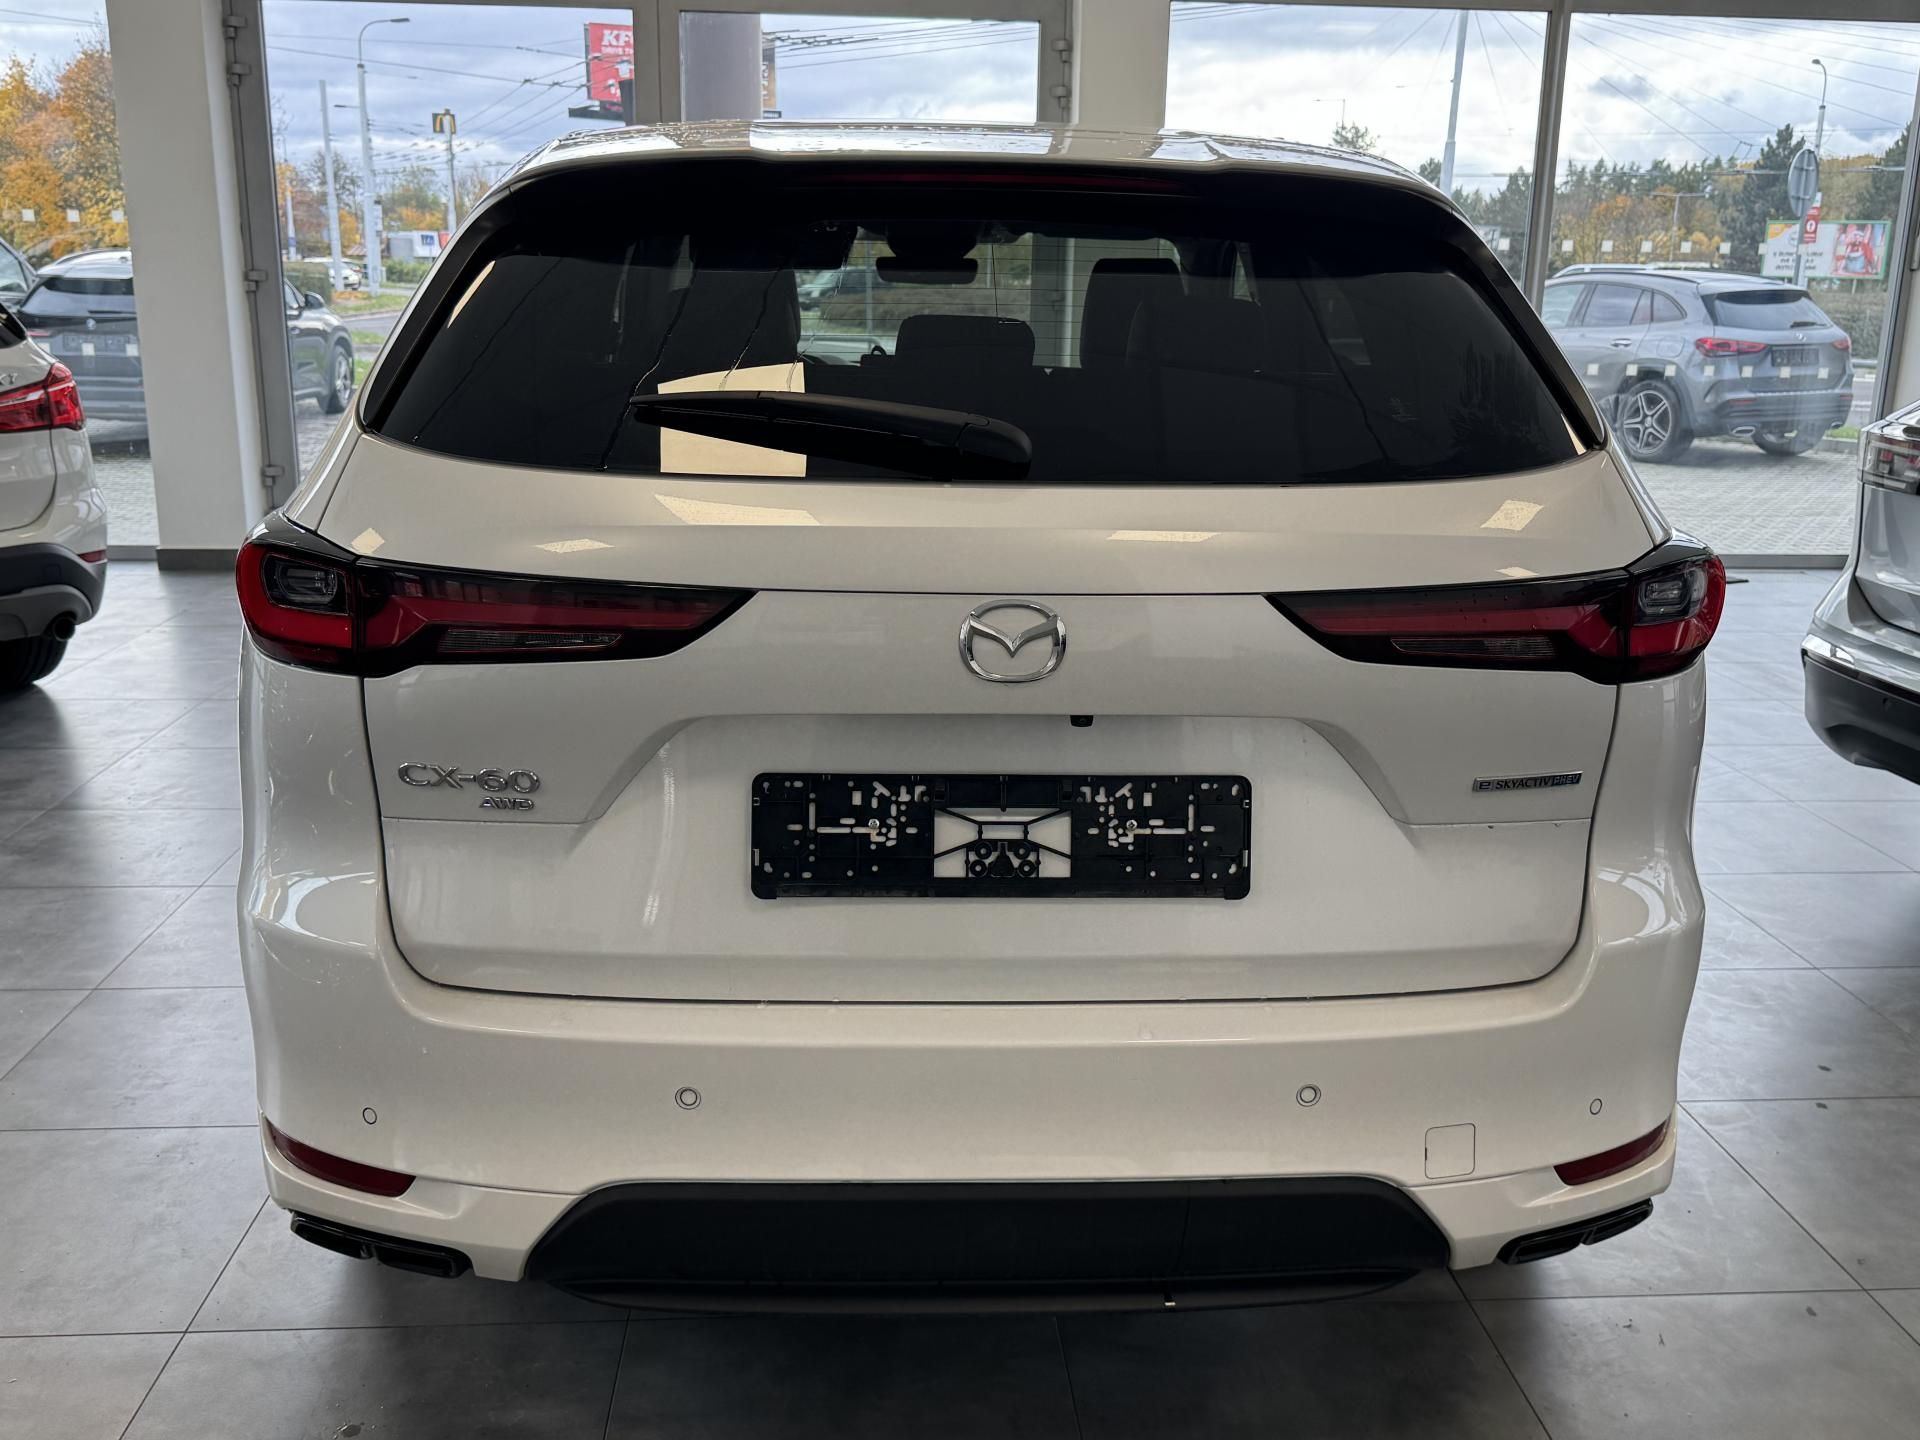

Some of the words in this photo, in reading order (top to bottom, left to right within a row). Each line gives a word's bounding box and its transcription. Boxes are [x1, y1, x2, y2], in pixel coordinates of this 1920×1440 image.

[601, 29, 633, 46] KF
[398, 762, 540, 793] CX-60
[1553, 775, 1580, 785] PHEV
[479, 796, 535, 810] AWD
